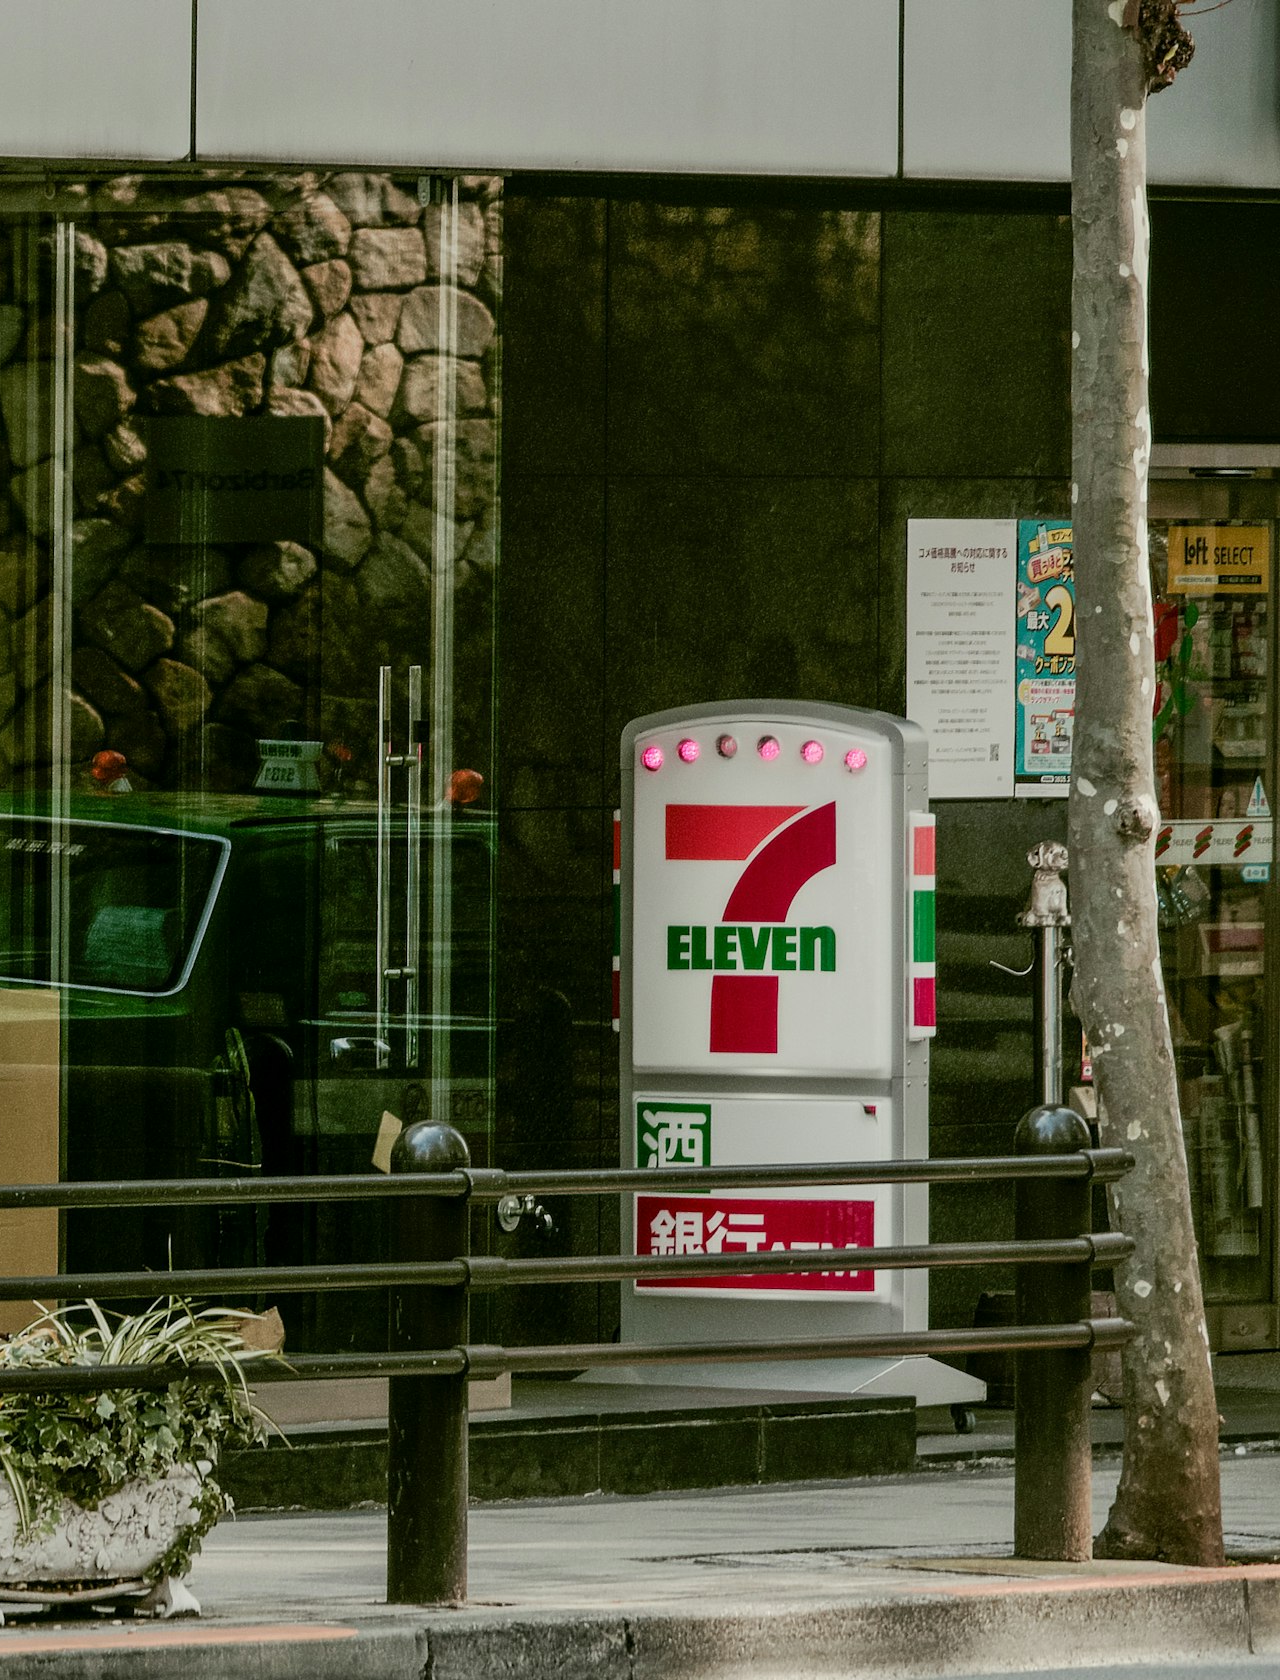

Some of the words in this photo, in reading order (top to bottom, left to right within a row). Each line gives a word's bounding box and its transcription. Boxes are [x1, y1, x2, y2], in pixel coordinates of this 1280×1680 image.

[950, 562, 976, 573] お知らせ
[1214, 546, 1254, 565] SELECT
[1027, 611, 1050, 630] 最大
[1045, 584, 1075, 655] 2
[665, 801, 836, 1053] 7
[642, 1110, 704, 1169] 酒
